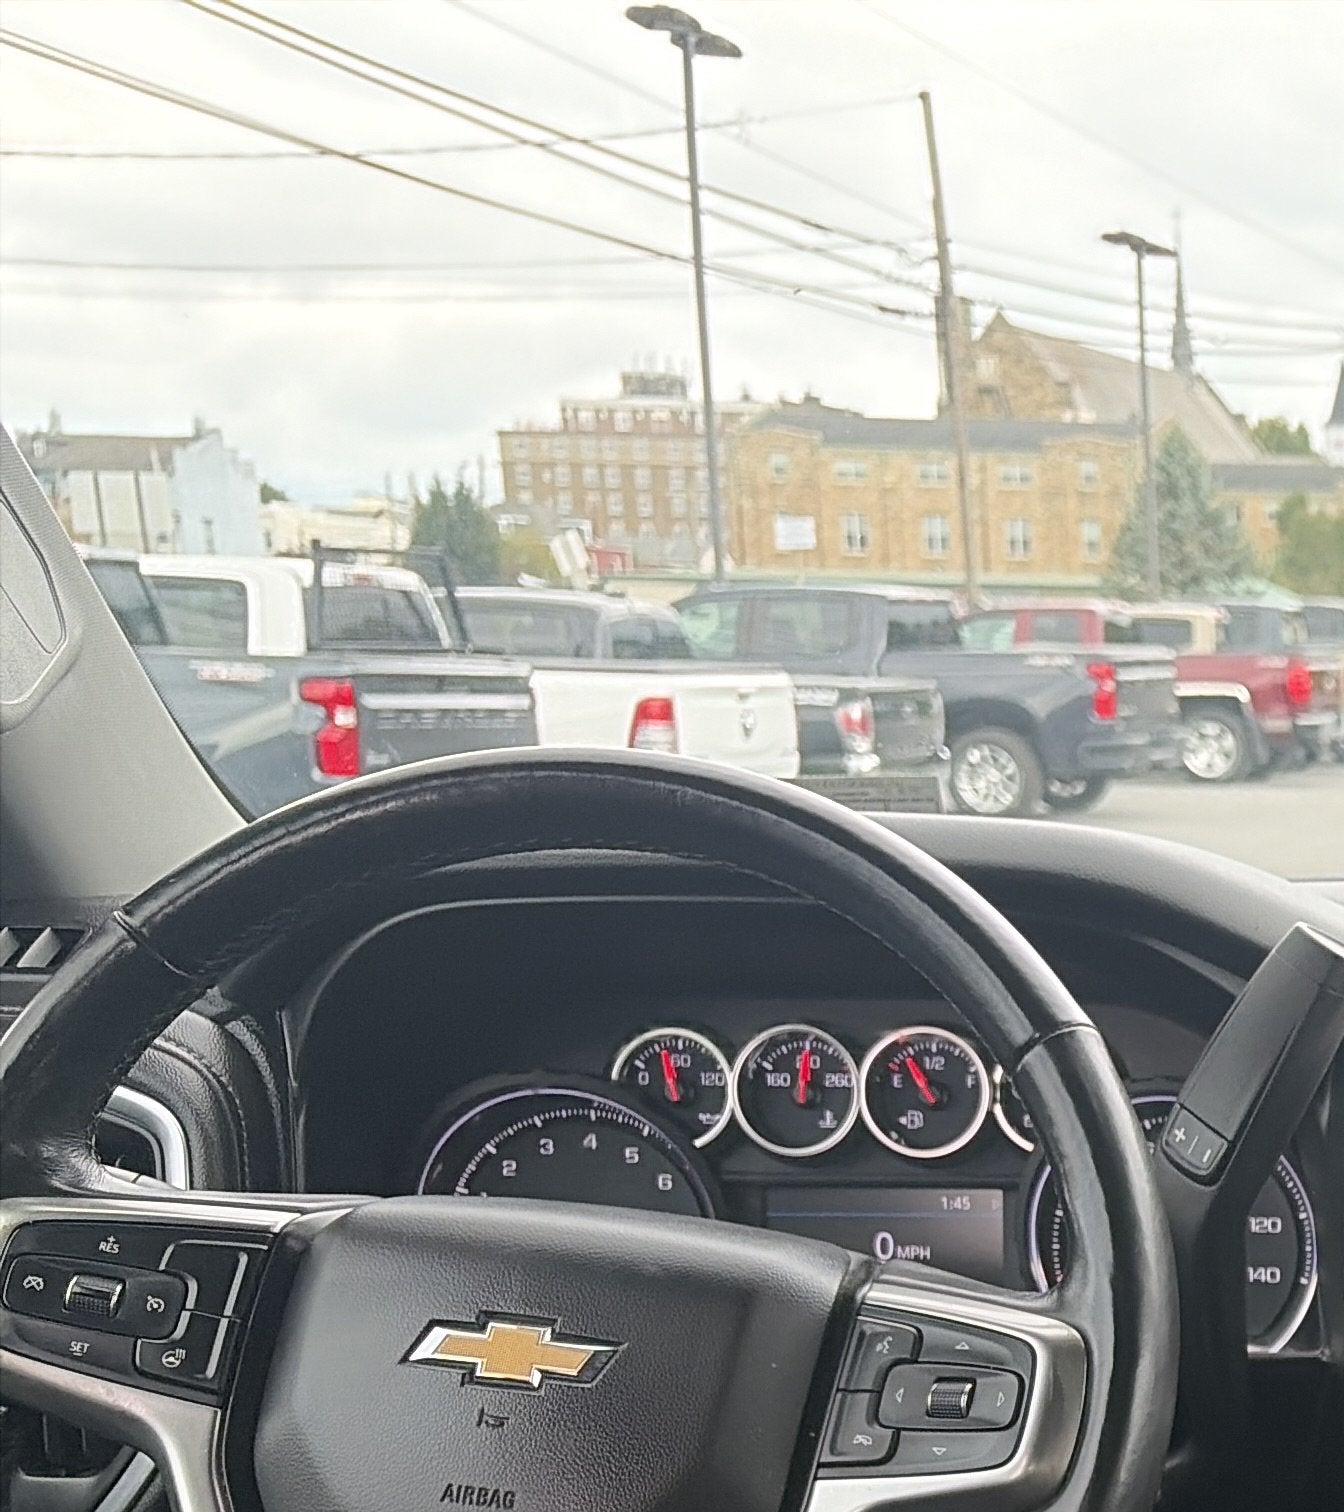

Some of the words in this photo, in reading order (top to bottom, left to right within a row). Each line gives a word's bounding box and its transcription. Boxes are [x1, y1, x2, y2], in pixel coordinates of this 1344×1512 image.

[923, 1056, 945, 1071] 1/2
[638, 1072, 650, 1086] 0
[700, 1071, 725, 1087] 120
[765, 1072, 791, 1087] 160
[825, 1072, 854, 1088] 260
[893, 1074, 903, 1088] E
[966, 1074, 976, 1088] F
[539, 1137, 554, 1155] 3
[583, 1132, 598, 1150] 4
[625, 1146, 640, 1164] 5
[502, 1159, 517, 1177] 2
[657, 1173, 673, 1191] 6
[940, 1195, 971, 1211] 1:45
[1248, 1216, 1282, 1234] 120
[98, 1241, 120, 1254] RES
[874, 1230, 895, 1262] 0
[896, 1245, 931, 1260] MPH
[1247, 1266, 1281, 1284] 140
[69, 1340, 90, 1353] SET
[439, 1482, 516, 1510] AIRBAG
